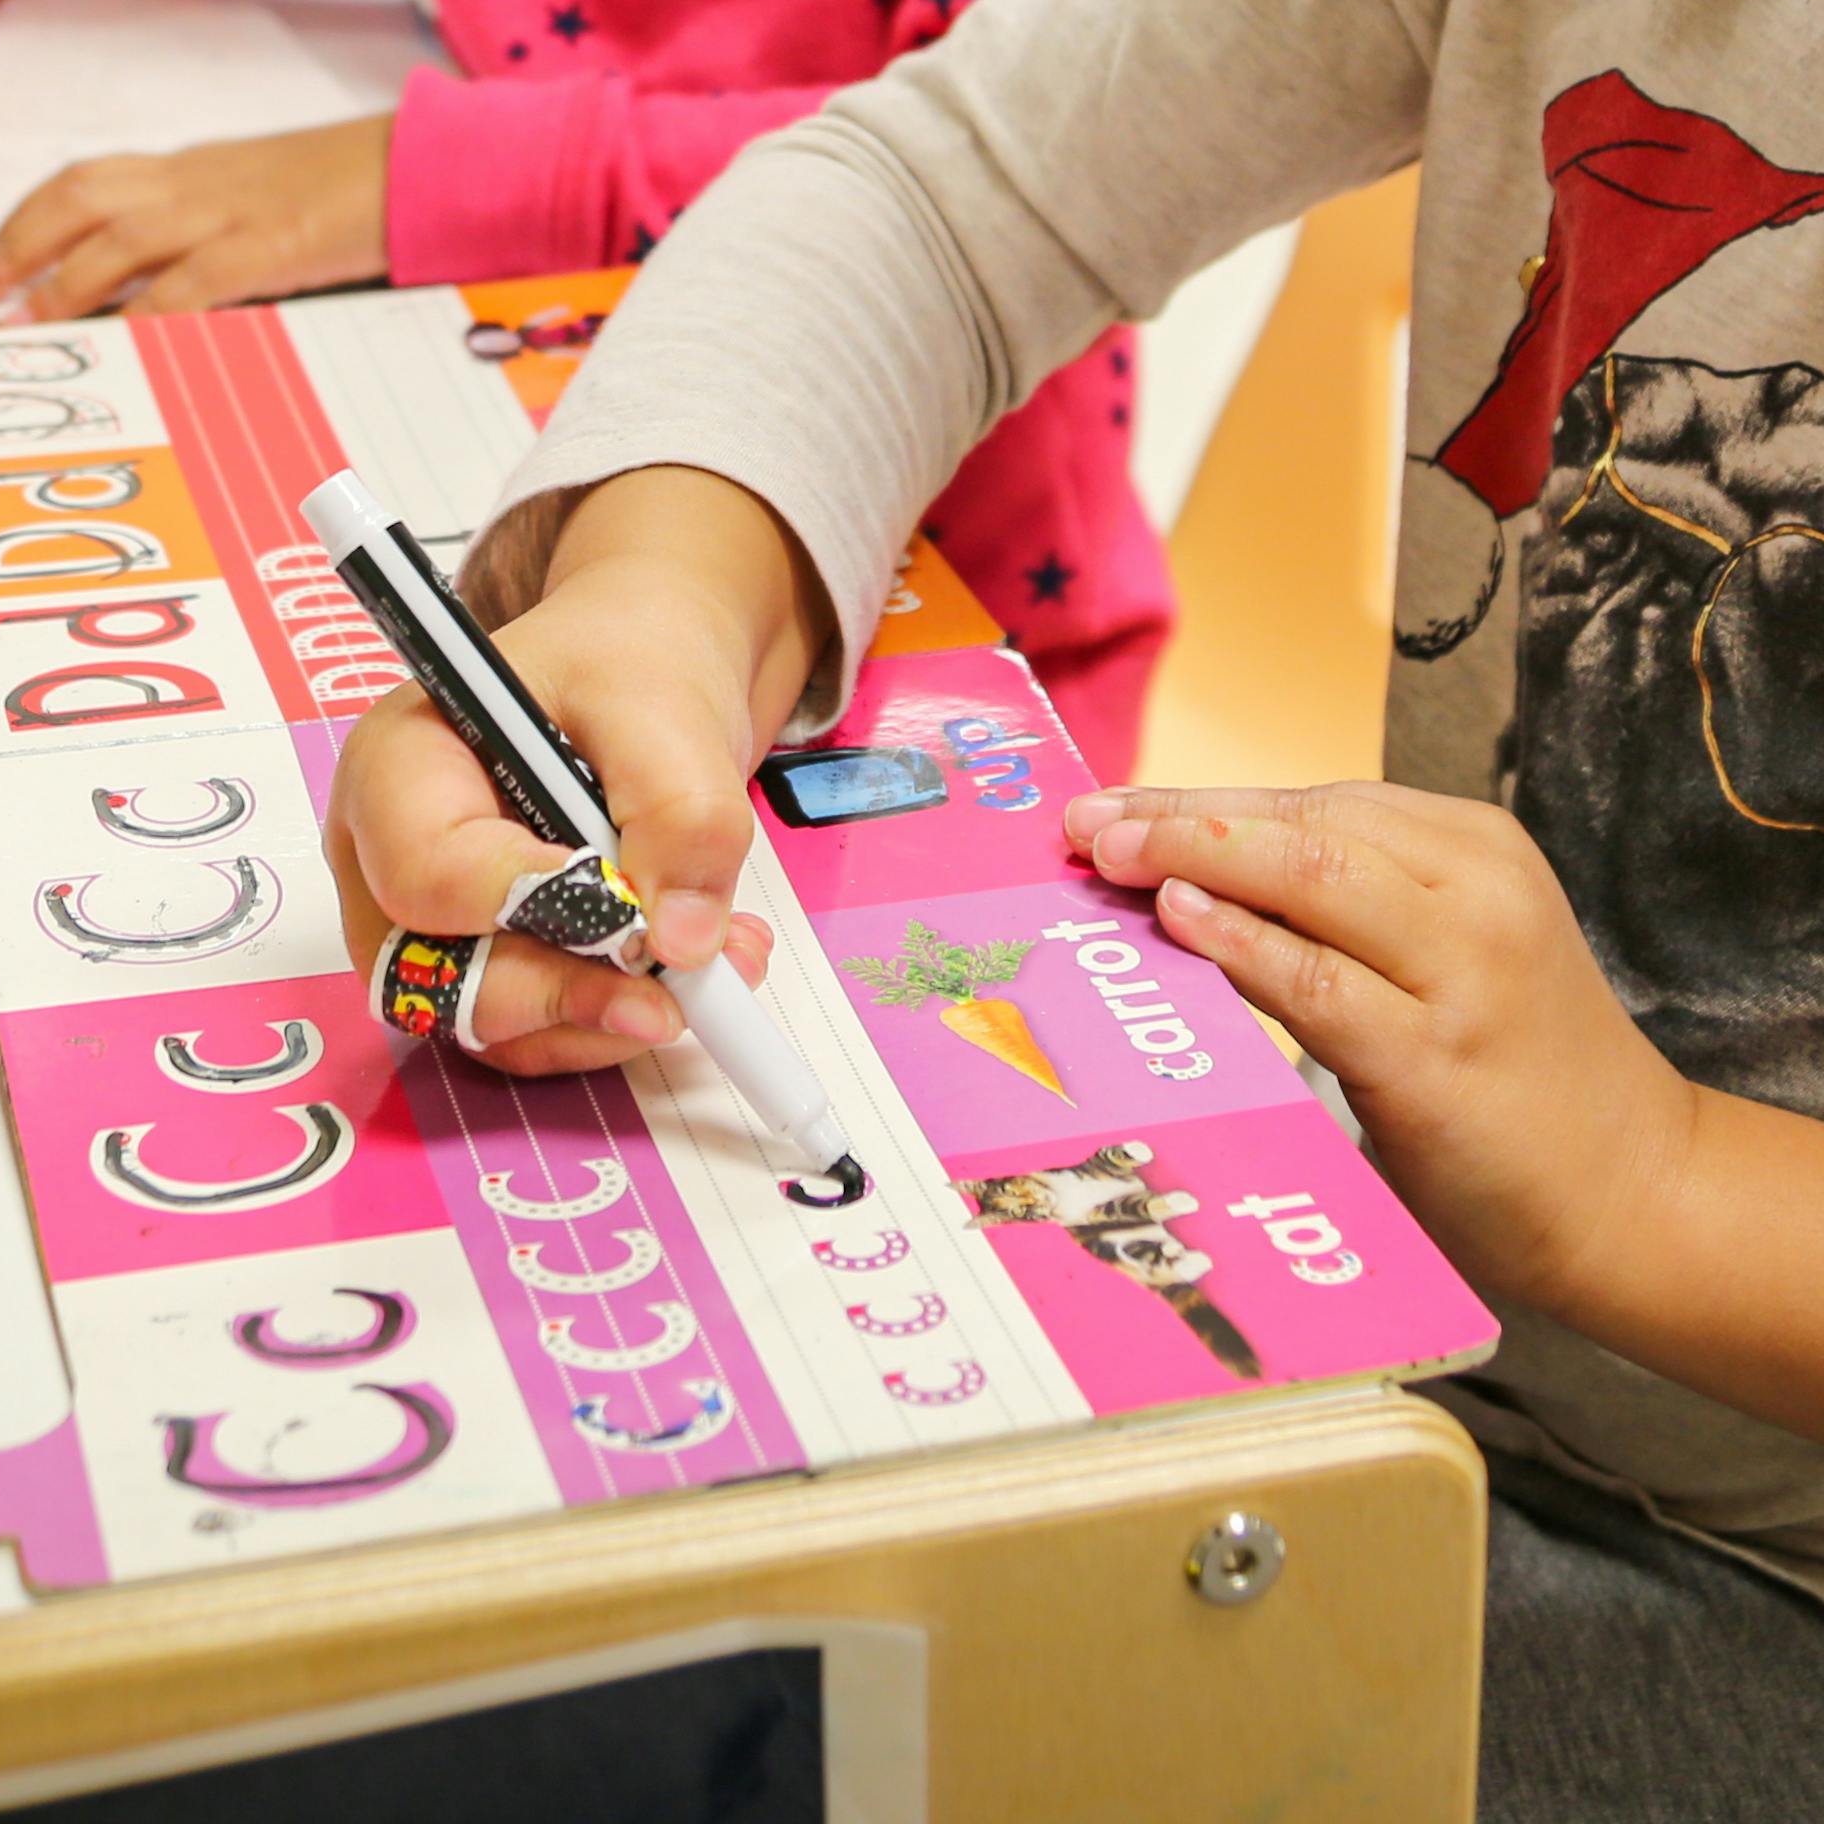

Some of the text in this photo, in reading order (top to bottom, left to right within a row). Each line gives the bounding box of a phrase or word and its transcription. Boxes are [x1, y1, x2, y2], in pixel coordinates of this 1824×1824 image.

[493, 760, 559, 842] MARKER
[942, 717, 1043, 812] cup
[1041, 919, 1214, 1080] carrot
[1226, 1191, 1364, 1286] cat
